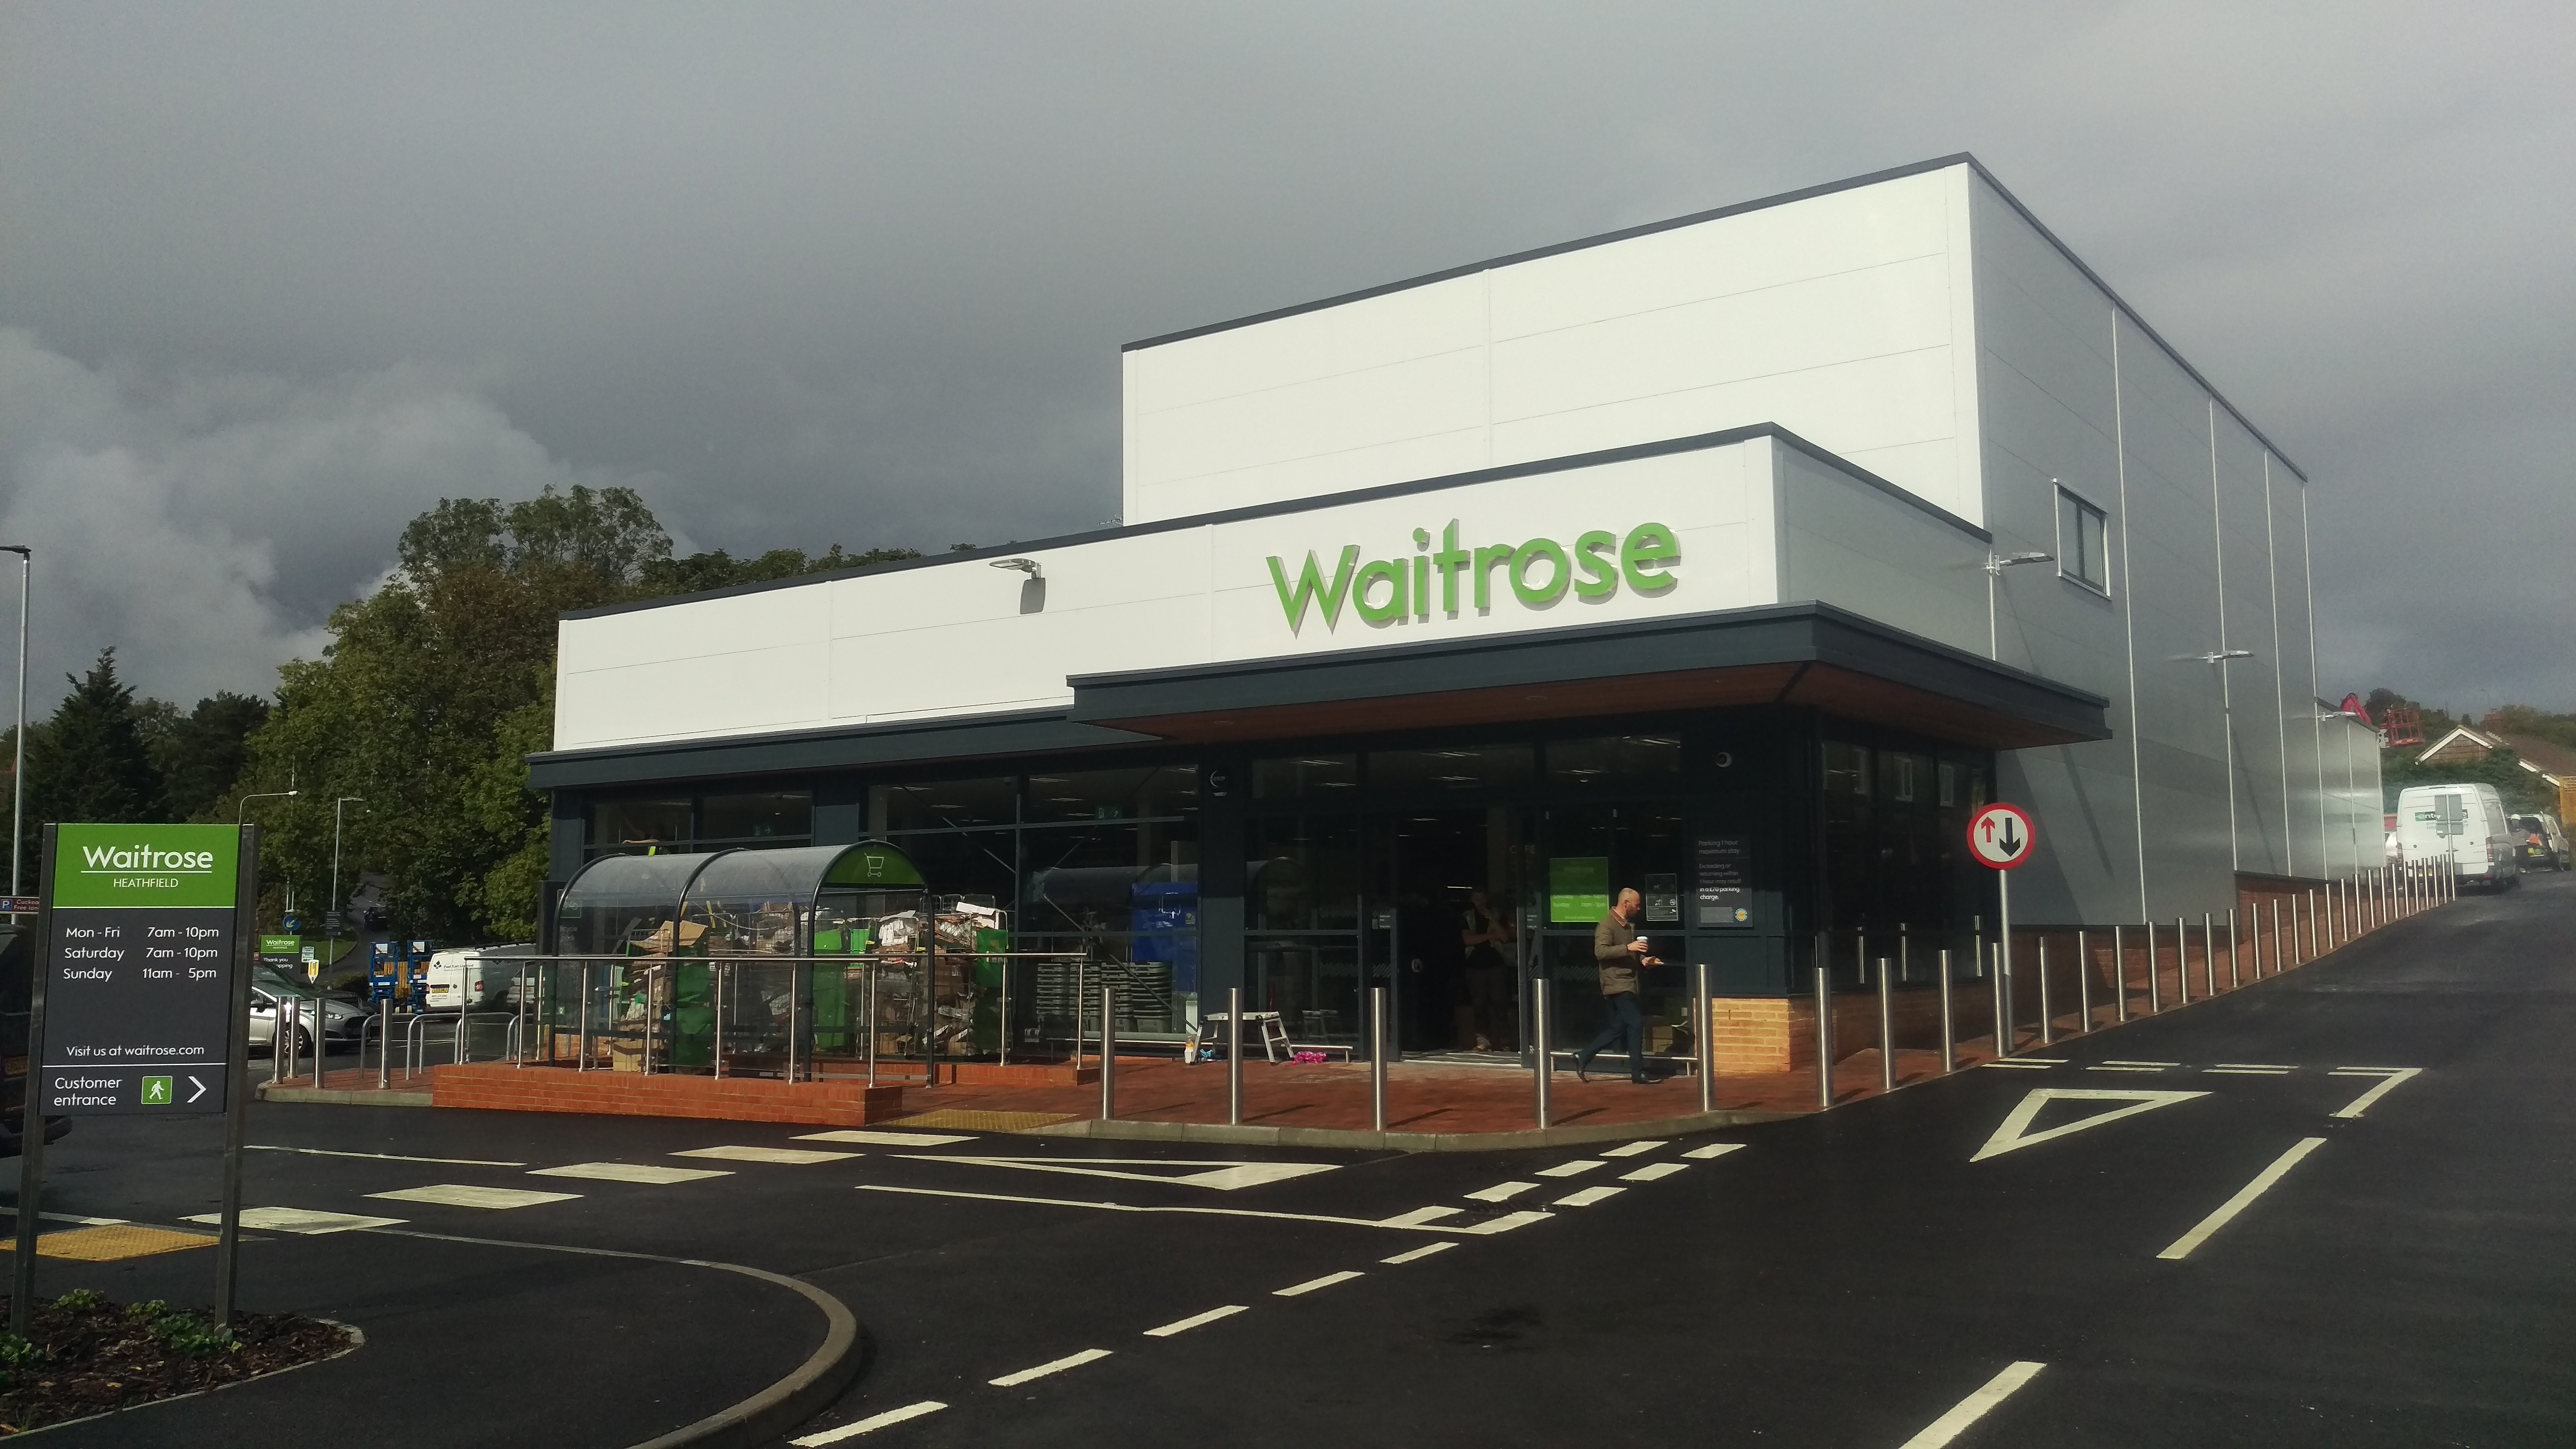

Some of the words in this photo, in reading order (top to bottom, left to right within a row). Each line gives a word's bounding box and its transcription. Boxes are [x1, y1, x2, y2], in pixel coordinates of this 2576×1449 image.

[1265, 518, 1681, 637] Waitrose
[82, 844, 213, 868] Waitrose
[114, 878, 179, 887] HEATHFIELD
[66, 928, 94, 938] Mon
[105, 927, 120, 938] Fri
[147, 927, 175, 937] 7am
[185, 927, 219, 941] 10pm
[64, 946, 125, 962] Saturday
[146, 947, 174, 958] 7am
[184, 947, 218, 961] 10pm
[63, 967, 113, 982] Sunday
[142, 968, 172, 978] 11am
[188, 967, 217, 981] 5pm
[66, 1045, 91, 1057] Visit
[93, 1048, 106, 1056] us
[109, 1045, 122, 1056] at
[125, 1045, 205, 1056] waitrose.com
[55, 1076, 123, 1089] Customer
[54, 1093, 116, 1106] entrance
